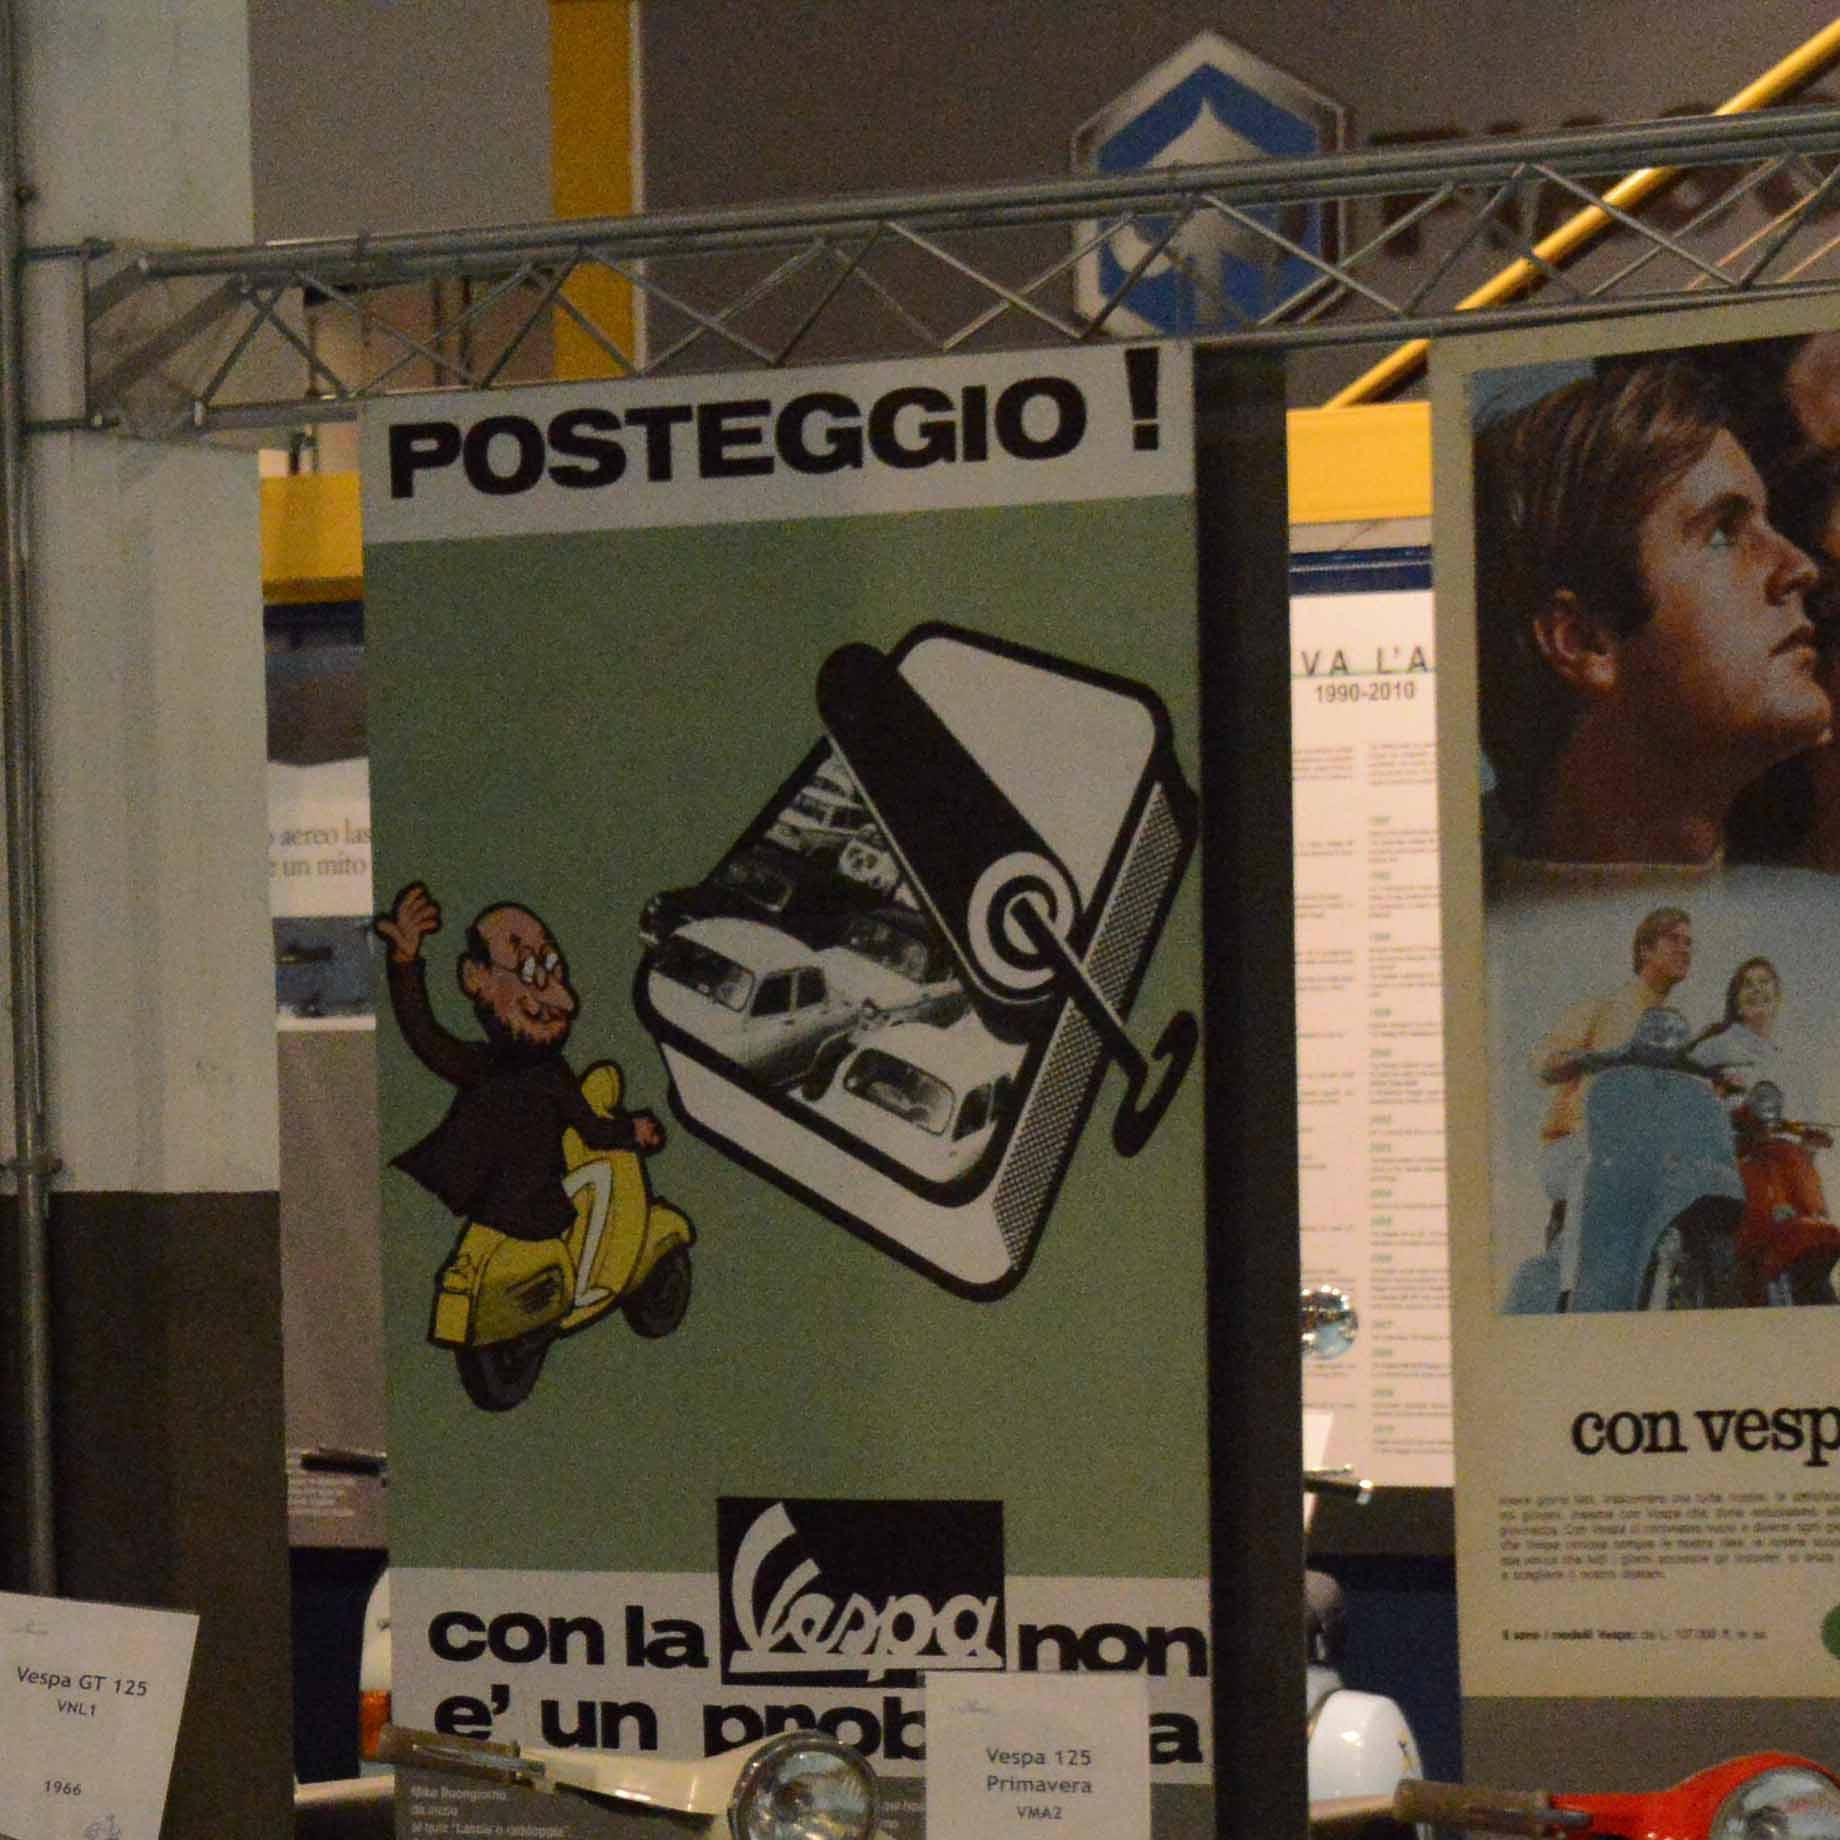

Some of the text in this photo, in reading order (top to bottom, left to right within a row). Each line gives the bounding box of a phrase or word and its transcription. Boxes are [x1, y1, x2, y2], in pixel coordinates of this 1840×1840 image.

[390, 376, 1087, 499] POSTEGGIO
[1316, 681, 1416, 703] 1990-2010
[316, 854, 367, 877] mito
[1572, 1409, 1688, 1455] con
[428, 1501, 1208, 1683] con la Vespa non
[17, 1666, 149, 1698] Vespa GT 125
[540, 1696, 658, 1752] un
[986, 1748, 1093, 1769] Vespa 125
[44, 1781, 83, 1797] 1966
[986, 1774, 1094, 1795] Primavera
[1017, 1806, 1064, 1821] VMA2
